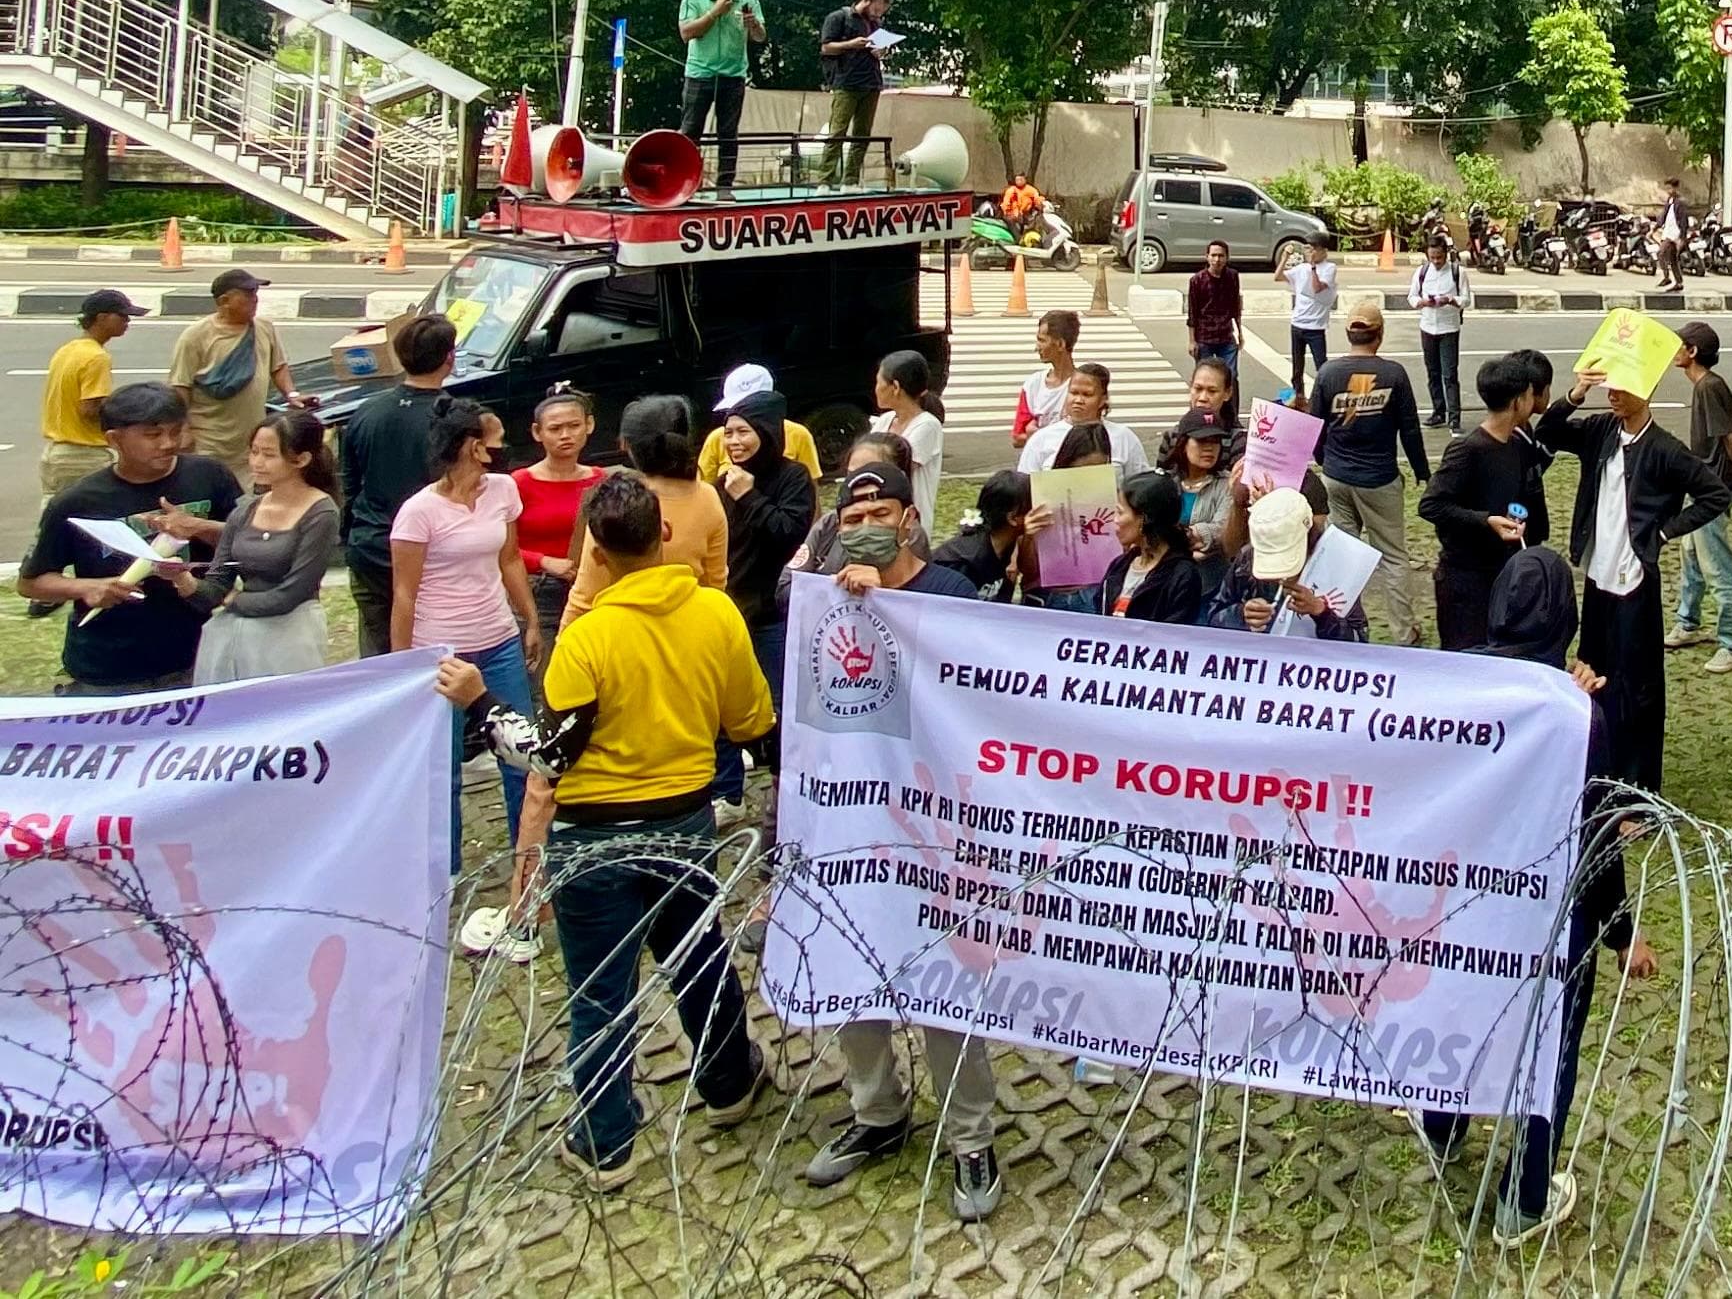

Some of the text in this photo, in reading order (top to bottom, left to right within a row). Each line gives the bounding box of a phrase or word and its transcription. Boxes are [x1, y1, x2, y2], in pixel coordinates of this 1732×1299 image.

[680, 201, 960, 254] SUARA RAKYAT
[830, 676, 883, 691] KORUPSI
[1056, 637, 1397, 699] GERAKAN ANTI KORUPSI
[939, 662, 1506, 753] PEMUDA KALIMANTAN BARAT (GAKPKB)
[0, 740, 331, 789] BARAT (GAKPKB)
[977, 740, 1374, 818] STOP KORUPSI !!
[899, 786, 932, 816] KPK
[937, 796, 953, 822] RI
[958, 803, 1015, 834] FOKUS
[1022, 811, 1120, 843] TERHADAP
[1125, 823, 1229, 860] KEPASTIAN
[1395, 857, 1459, 888] KASUS
[1465, 864, 1548, 900] KORUPSI
[1055, 856, 1132, 889] NORSAN
[818, 858, 891, 887] TUNTAS
[896, 860, 950, 896] KASUS
[1022, 891, 1073, 922] DANA
[1079, 900, 1137, 932] HIBAH
[1323, 931, 1342, 958] DI
[1400, 937, 1523, 979] MEMPAWAH
[1530, 954, 1568, 983] DN
[917, 906, 968, 940] PDAM
[974, 919, 992, 945] DI
[1043, 932, 1163, 976] MEMPAWAH
